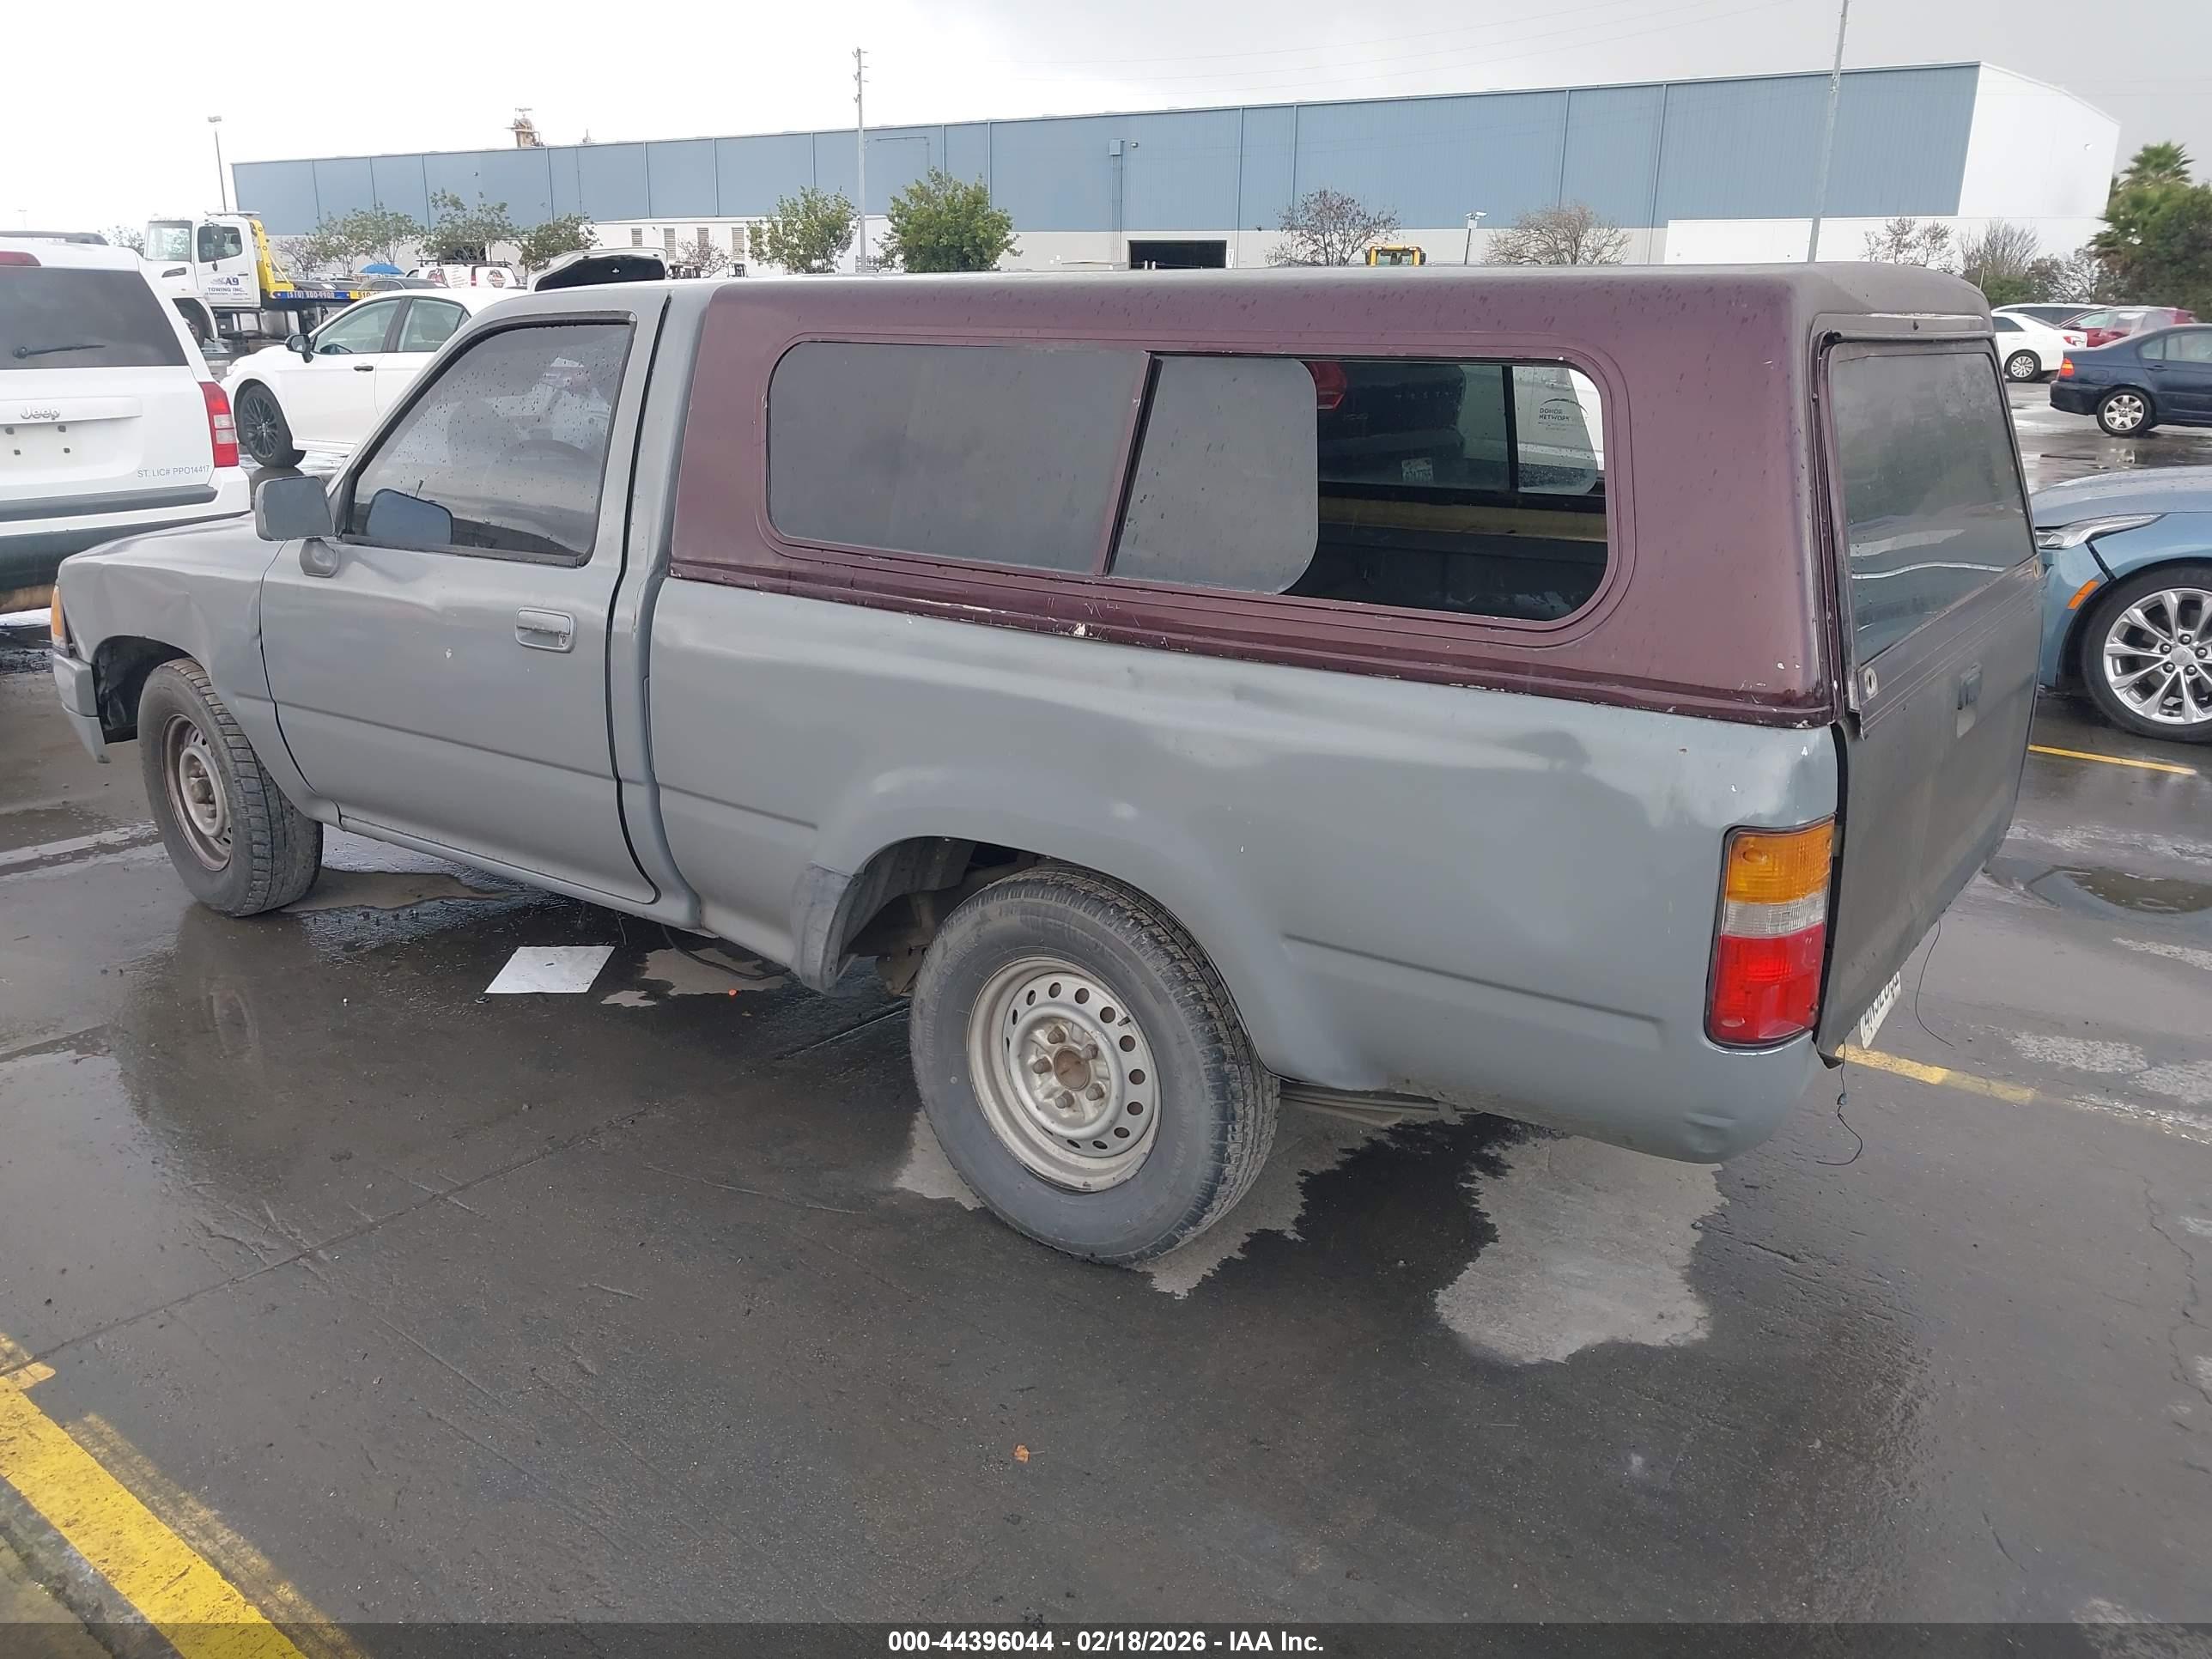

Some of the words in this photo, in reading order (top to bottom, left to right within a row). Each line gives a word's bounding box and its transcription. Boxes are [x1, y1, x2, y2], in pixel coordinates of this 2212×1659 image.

[225, 276, 240, 286] A9
[21, 404, 60, 420] Jeep
[152, 468, 170, 477] LIC#
